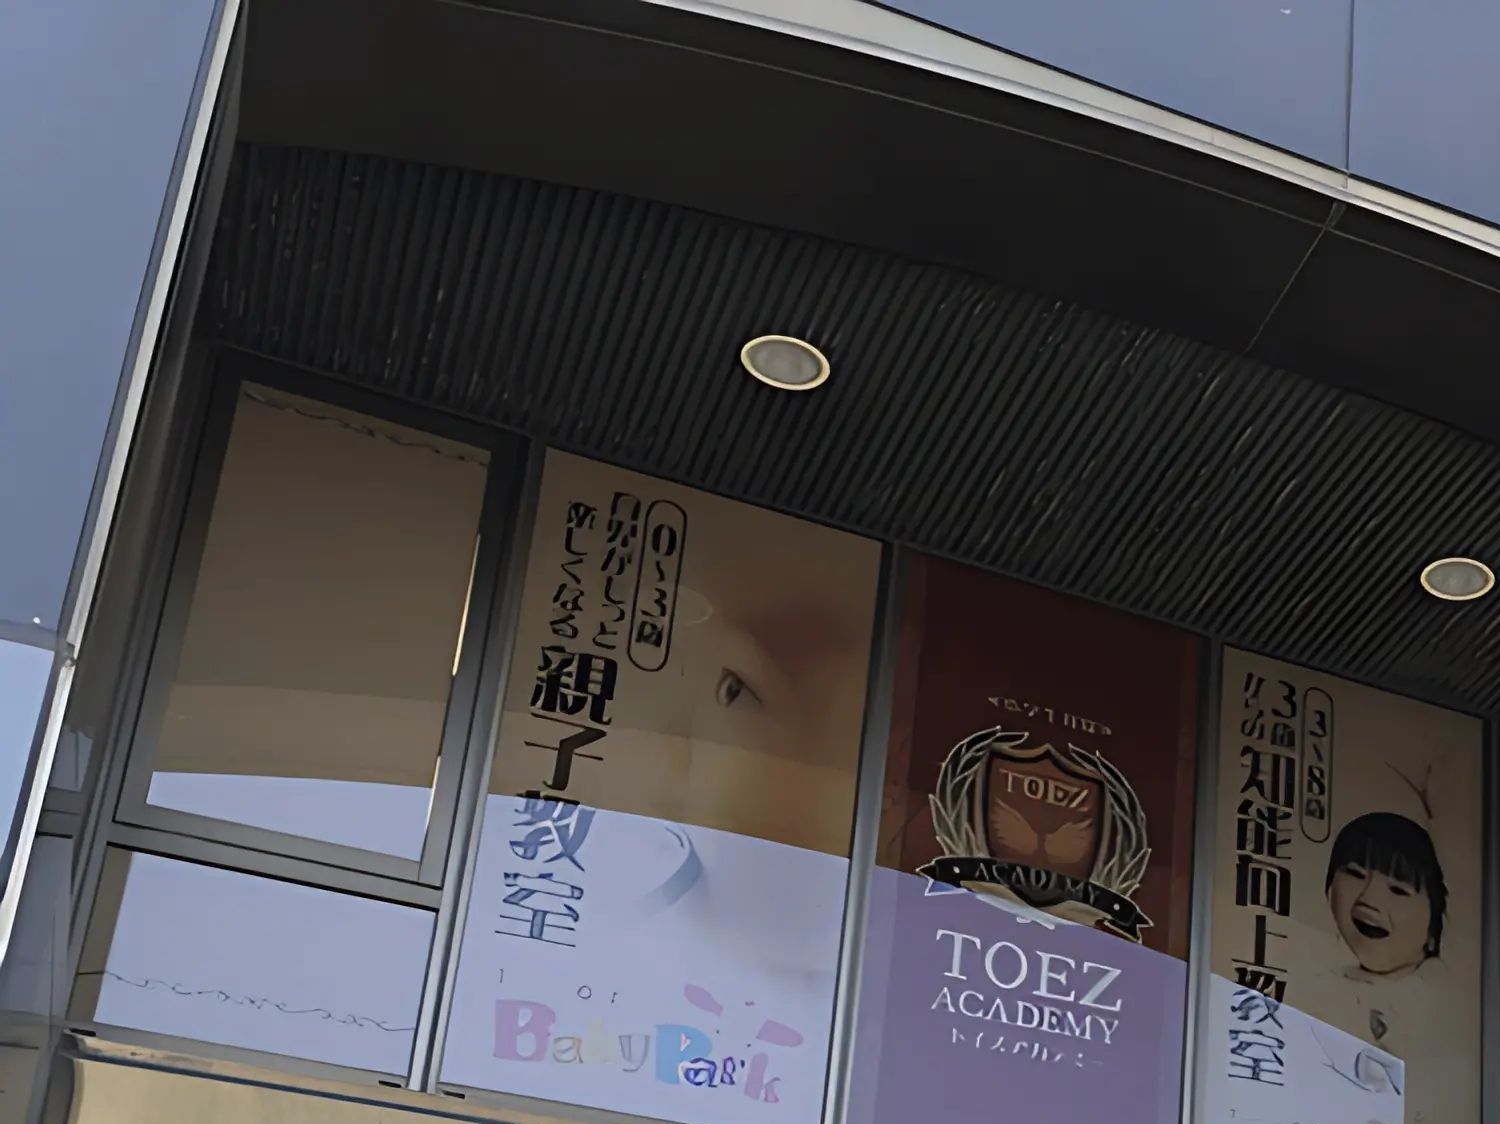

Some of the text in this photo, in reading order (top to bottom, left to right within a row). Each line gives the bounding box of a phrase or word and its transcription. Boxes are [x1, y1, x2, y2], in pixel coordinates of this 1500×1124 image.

[1000, 768, 1094, 812] TOEZ
[936, 928, 1122, 1012] TOEZ
[930, 986, 1119, 1044] ACADEMY
